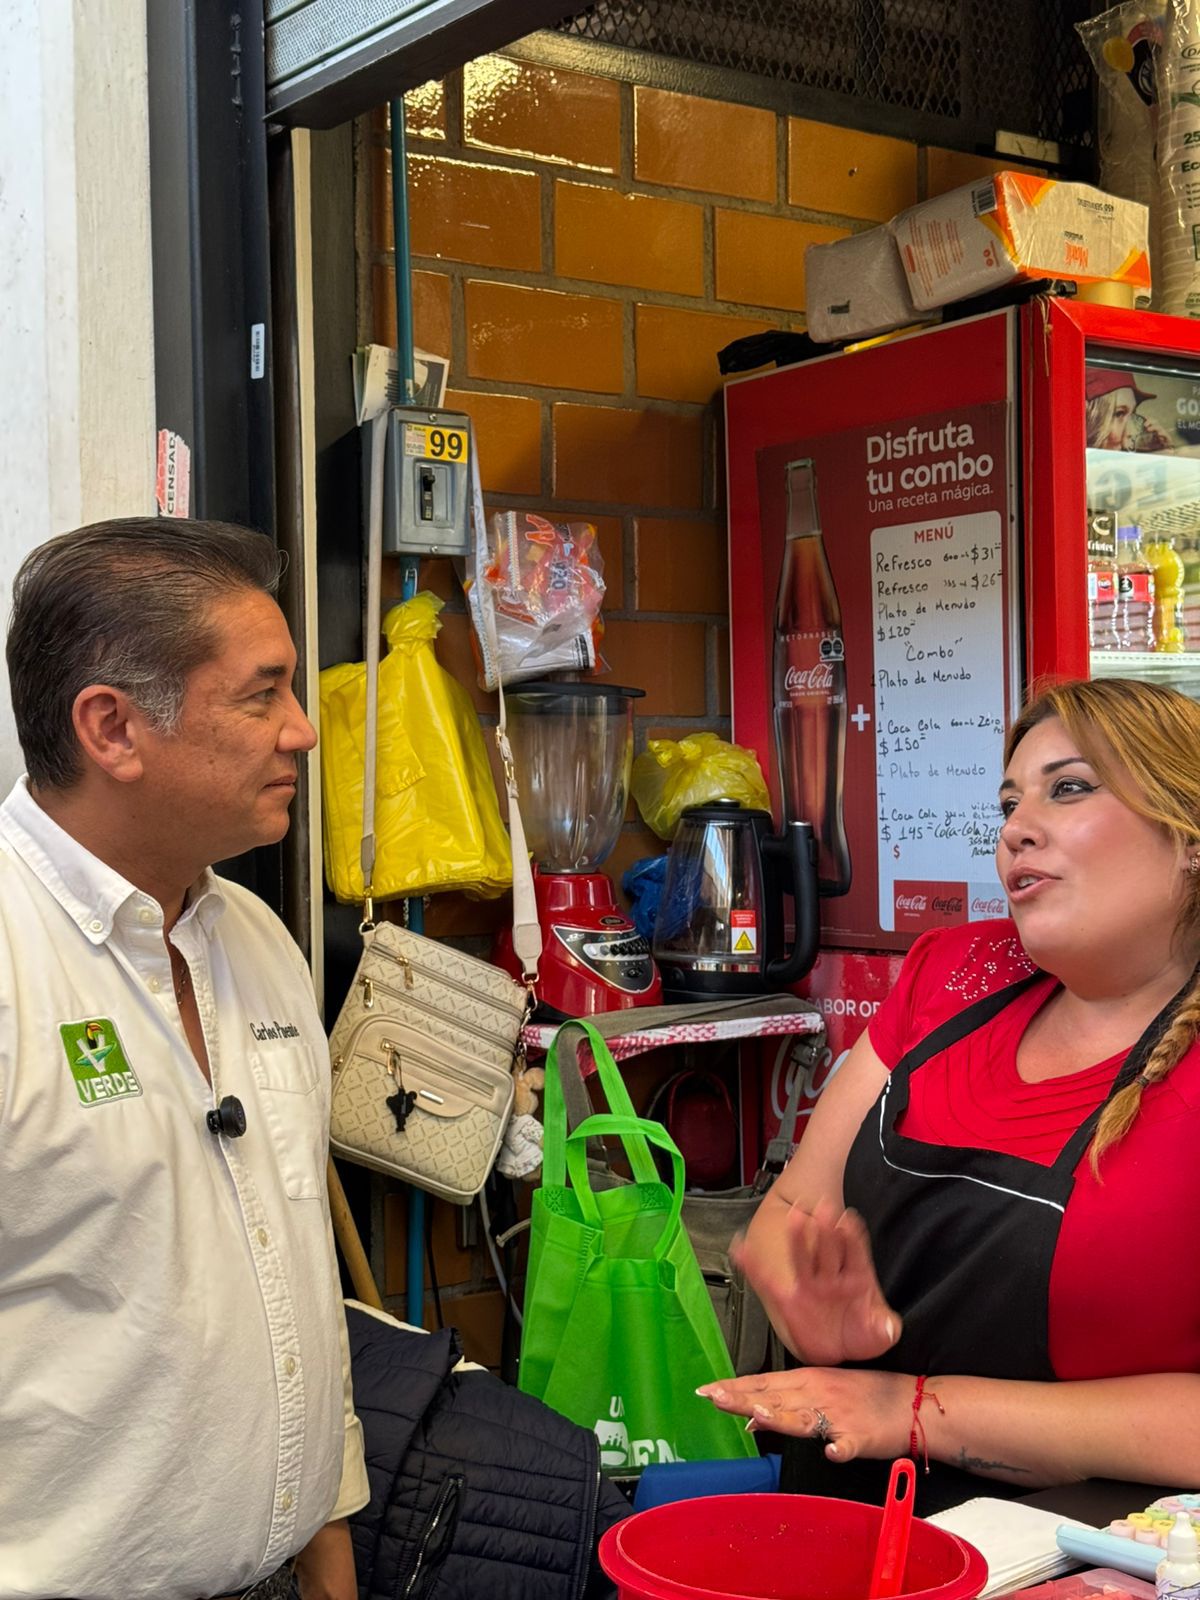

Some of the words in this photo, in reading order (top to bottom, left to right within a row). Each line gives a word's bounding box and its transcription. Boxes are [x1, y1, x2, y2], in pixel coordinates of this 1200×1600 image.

[430, 429, 463, 460] 99
[866, 421, 974, 464] Disfruta
[866, 468, 893, 495] tu
[900, 452, 994, 490] combo
[869, 499, 894, 513] Una
[897, 491, 937, 508] receta
[941, 483, 994, 501] mágica.
[913, 522, 954, 544] MENÚ
[876, 552, 932, 573] Refresco
[877, 580, 928, 598] Refresco
[878, 602, 907, 620] Plato
[916, 602, 926, 615] de
[935, 598, 976, 612] Menudo
[780, 630, 838, 643] RETORNABLE
[878, 669, 908, 689] Plato
[914, 670, 926, 684] de
[933, 667, 971, 682] Menudo
[888, 719, 911, 734] Coca
[918, 718, 941, 732] Cola
[890, 762, 920, 779] Plato
[928, 762, 939, 777] de
[891, 808, 914, 821] Coca
[918, 808, 938, 819] Cola
[250, 1022, 279, 1041] Carlos
[77, 1071, 140, 1102] VERDE
